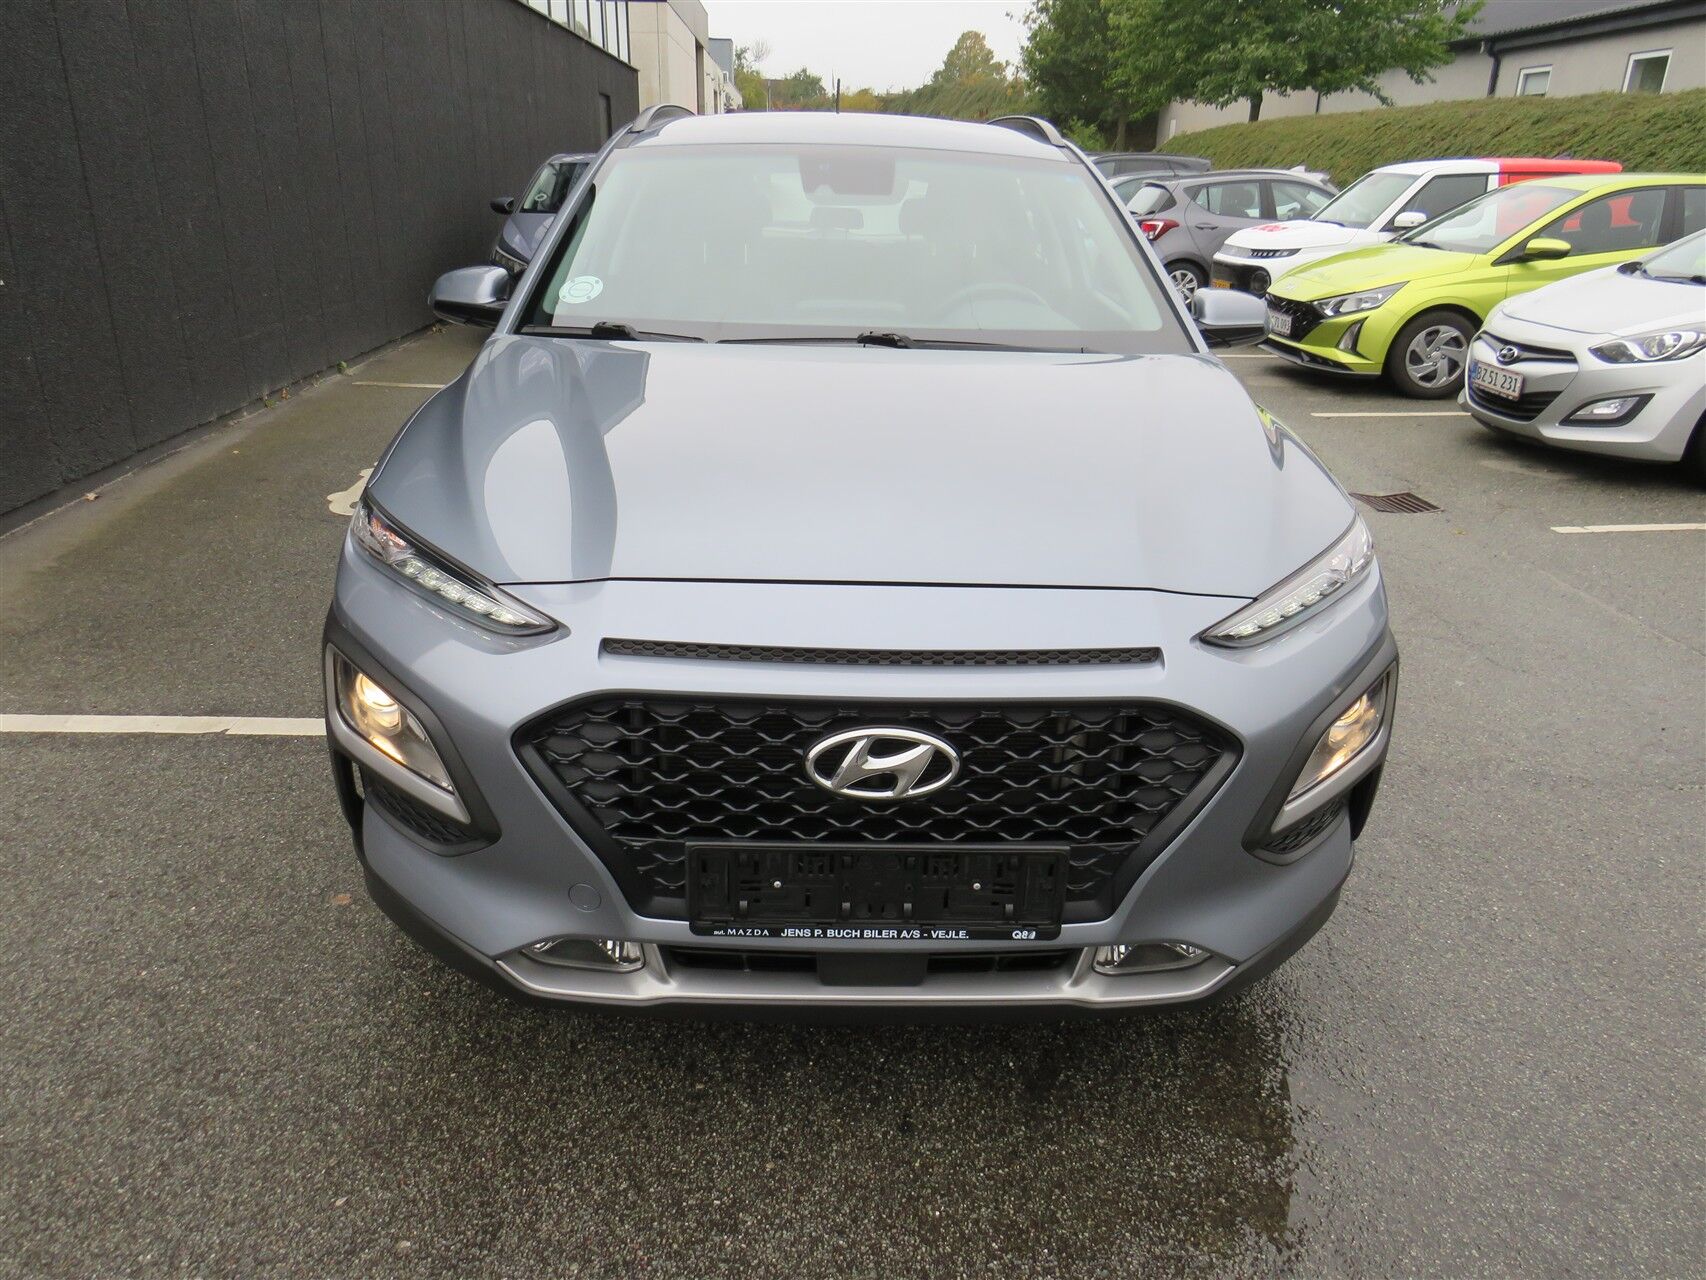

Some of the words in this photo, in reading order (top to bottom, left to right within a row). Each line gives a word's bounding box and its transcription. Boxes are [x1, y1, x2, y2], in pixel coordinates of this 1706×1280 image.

[1477, 366, 1488, 382] BZ
[1488, 371, 1499, 386] 51
[1500, 374, 1518, 392] 231
[781, 929, 811, 937] JENS
[814, 929, 824, 937] P.
[827, 929, 860, 938] BUCH
[863, 930, 898, 938] BILER
[900, 930, 920, 938] A/S
[931, 930, 969, 939] VEJLE.
